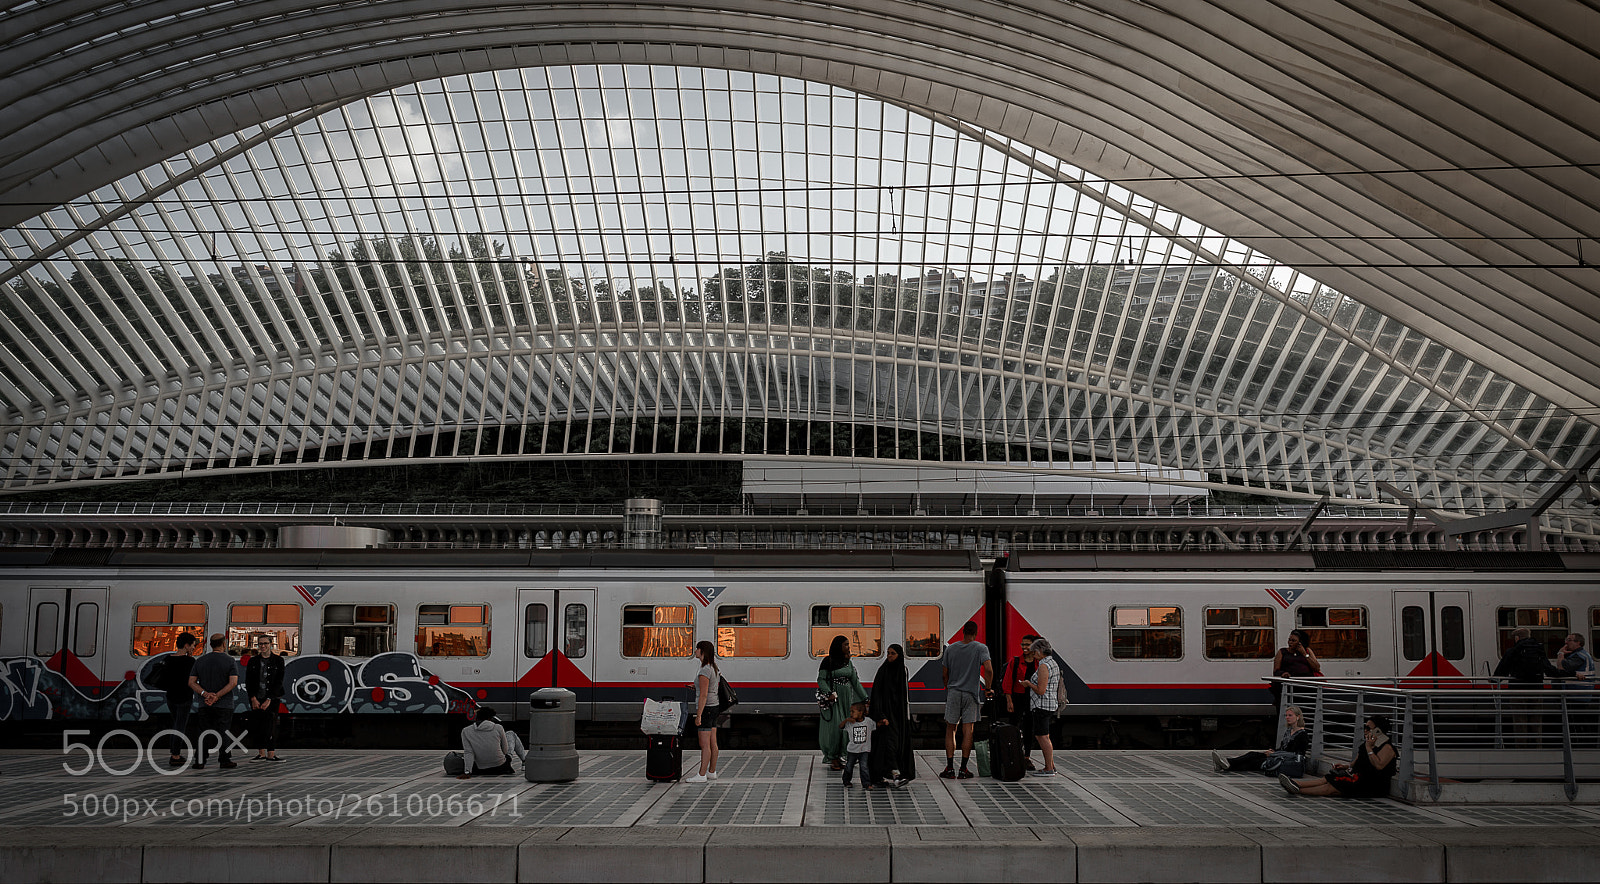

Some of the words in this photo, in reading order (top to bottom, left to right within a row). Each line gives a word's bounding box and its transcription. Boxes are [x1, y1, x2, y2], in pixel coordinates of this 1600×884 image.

[313, 586, 322, 597] 2
[707, 587, 716, 599] 2
[1286, 590, 1295, 601] 2
